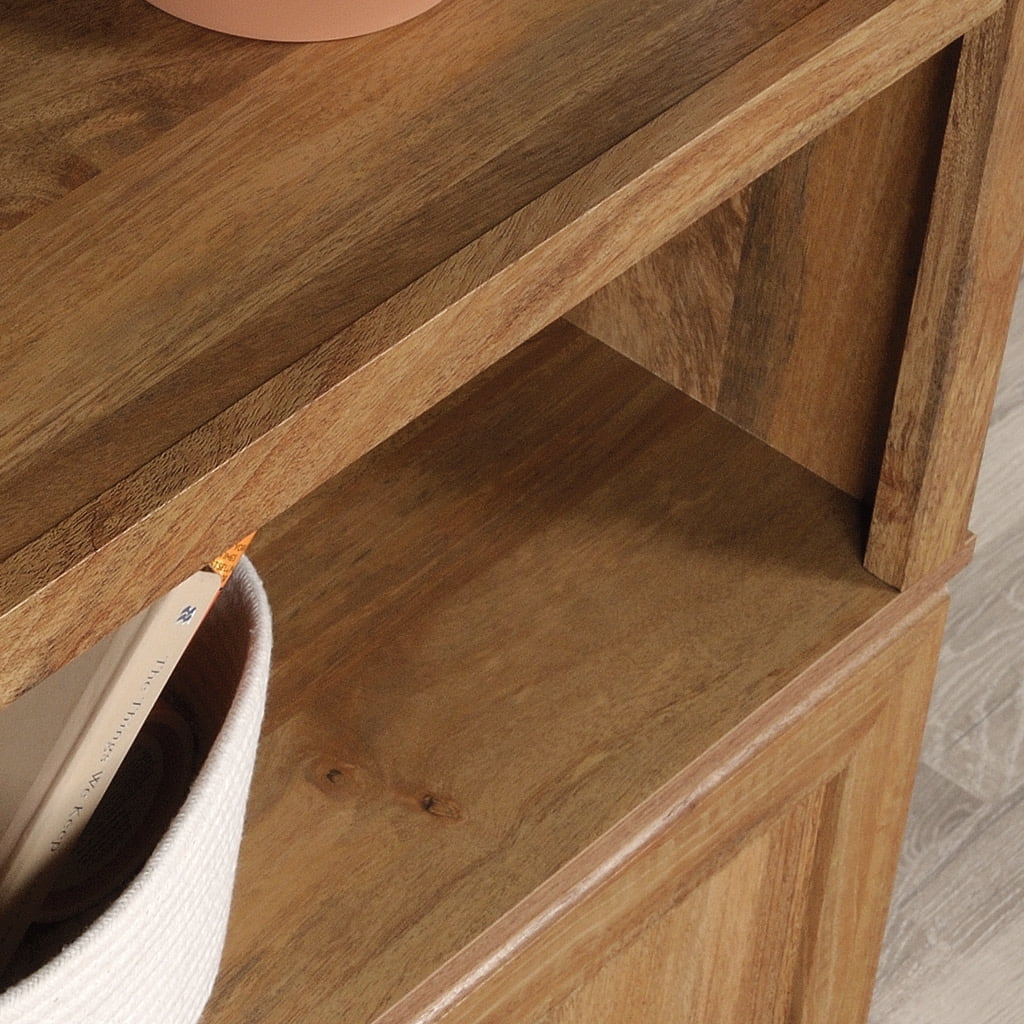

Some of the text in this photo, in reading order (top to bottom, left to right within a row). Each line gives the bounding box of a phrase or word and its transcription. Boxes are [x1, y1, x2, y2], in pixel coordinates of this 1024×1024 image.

[50, 657, 169, 853] The Things We Keep
